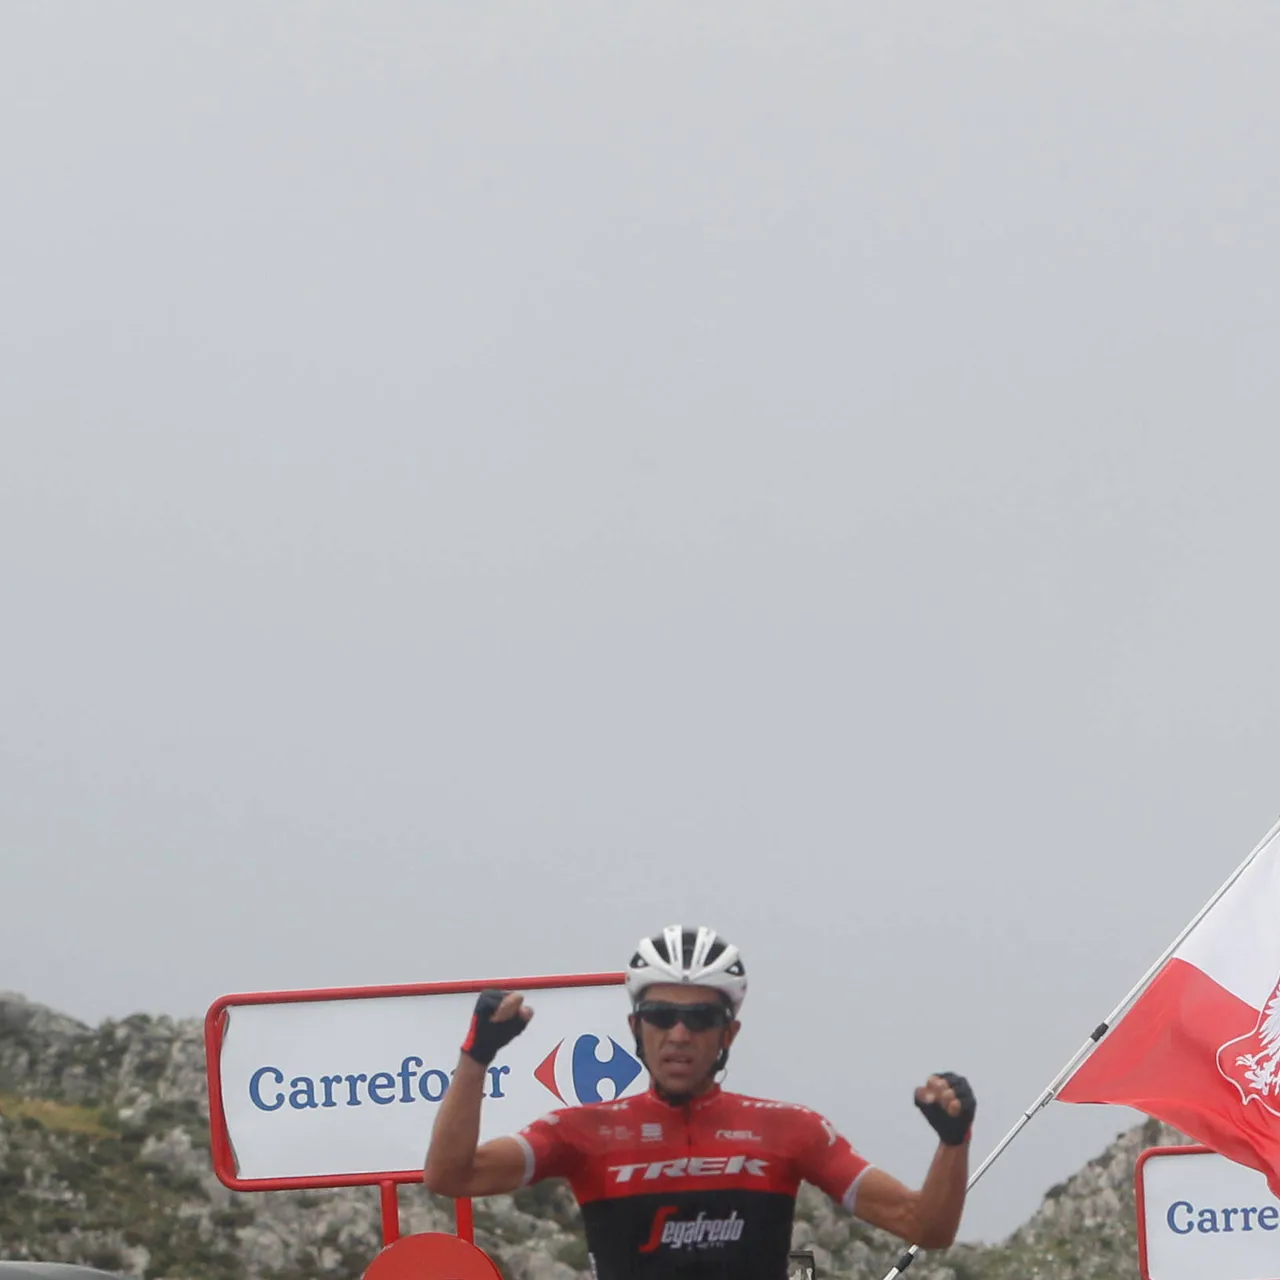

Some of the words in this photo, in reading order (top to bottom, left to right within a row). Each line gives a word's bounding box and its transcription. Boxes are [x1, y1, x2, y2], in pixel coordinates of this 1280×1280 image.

[249, 1056, 510, 1112] Carrefor
[608, 1155, 771, 1184] TREK
[638, 1205, 745, 1251] Segafredo
